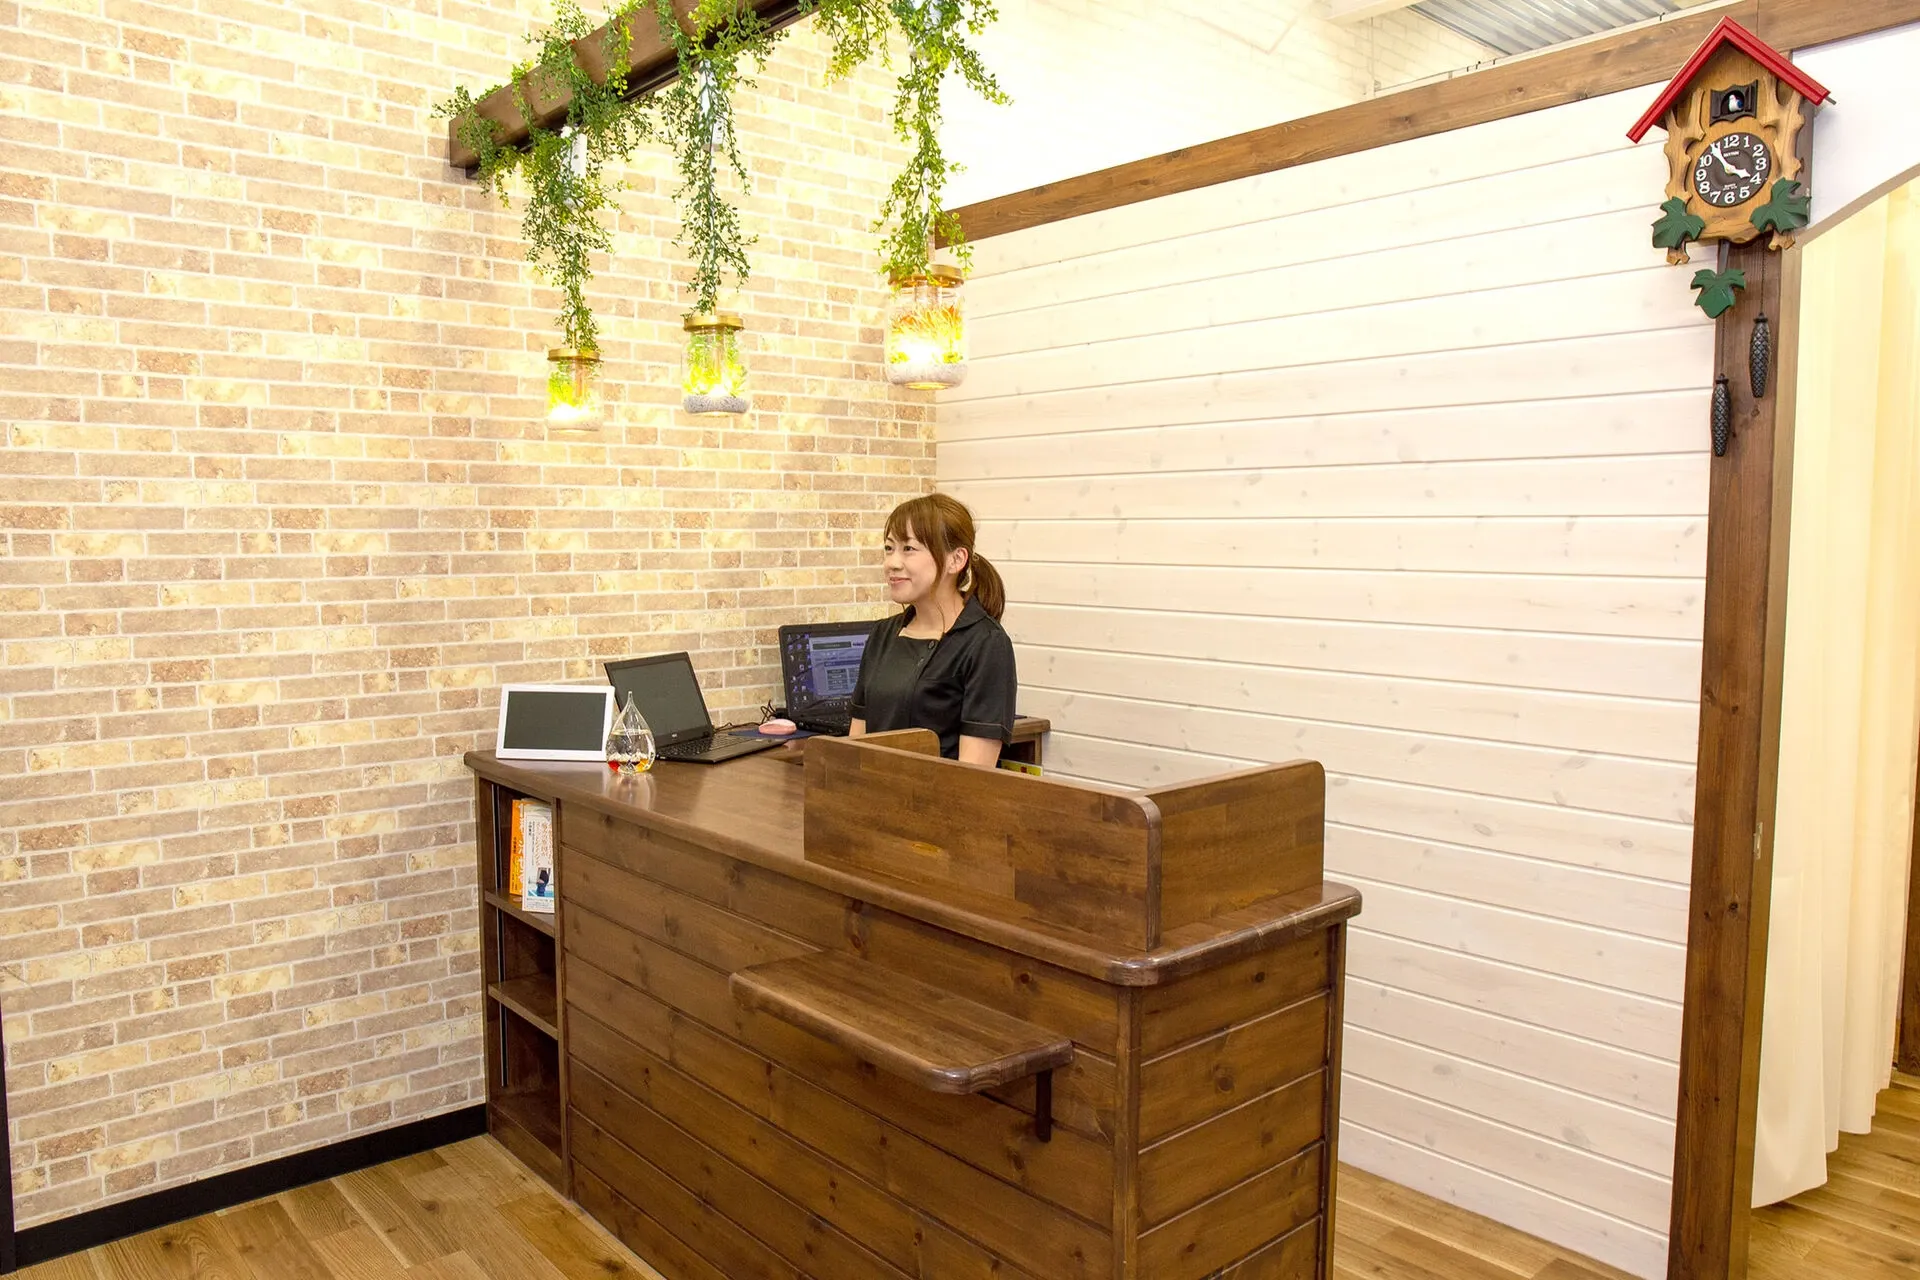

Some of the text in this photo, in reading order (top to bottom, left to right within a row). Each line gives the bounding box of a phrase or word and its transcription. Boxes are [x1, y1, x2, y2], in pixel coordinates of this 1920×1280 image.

[1724, 135, 1740, 148] 12
[1744, 136, 1750, 148] 1
[1752, 144, 1764, 157] 2
[1700, 154, 1712, 168] 10
[1756, 158, 1766, 170] 3
[1696, 169, 1706, 181] 9
[1750, 172, 1762, 184] 4
[1700, 182, 1710, 194] 8
[1739, 186, 1750, 198] 5
[1710, 191, 1721, 204] 7
[1724, 192, 1735, 204] 6
